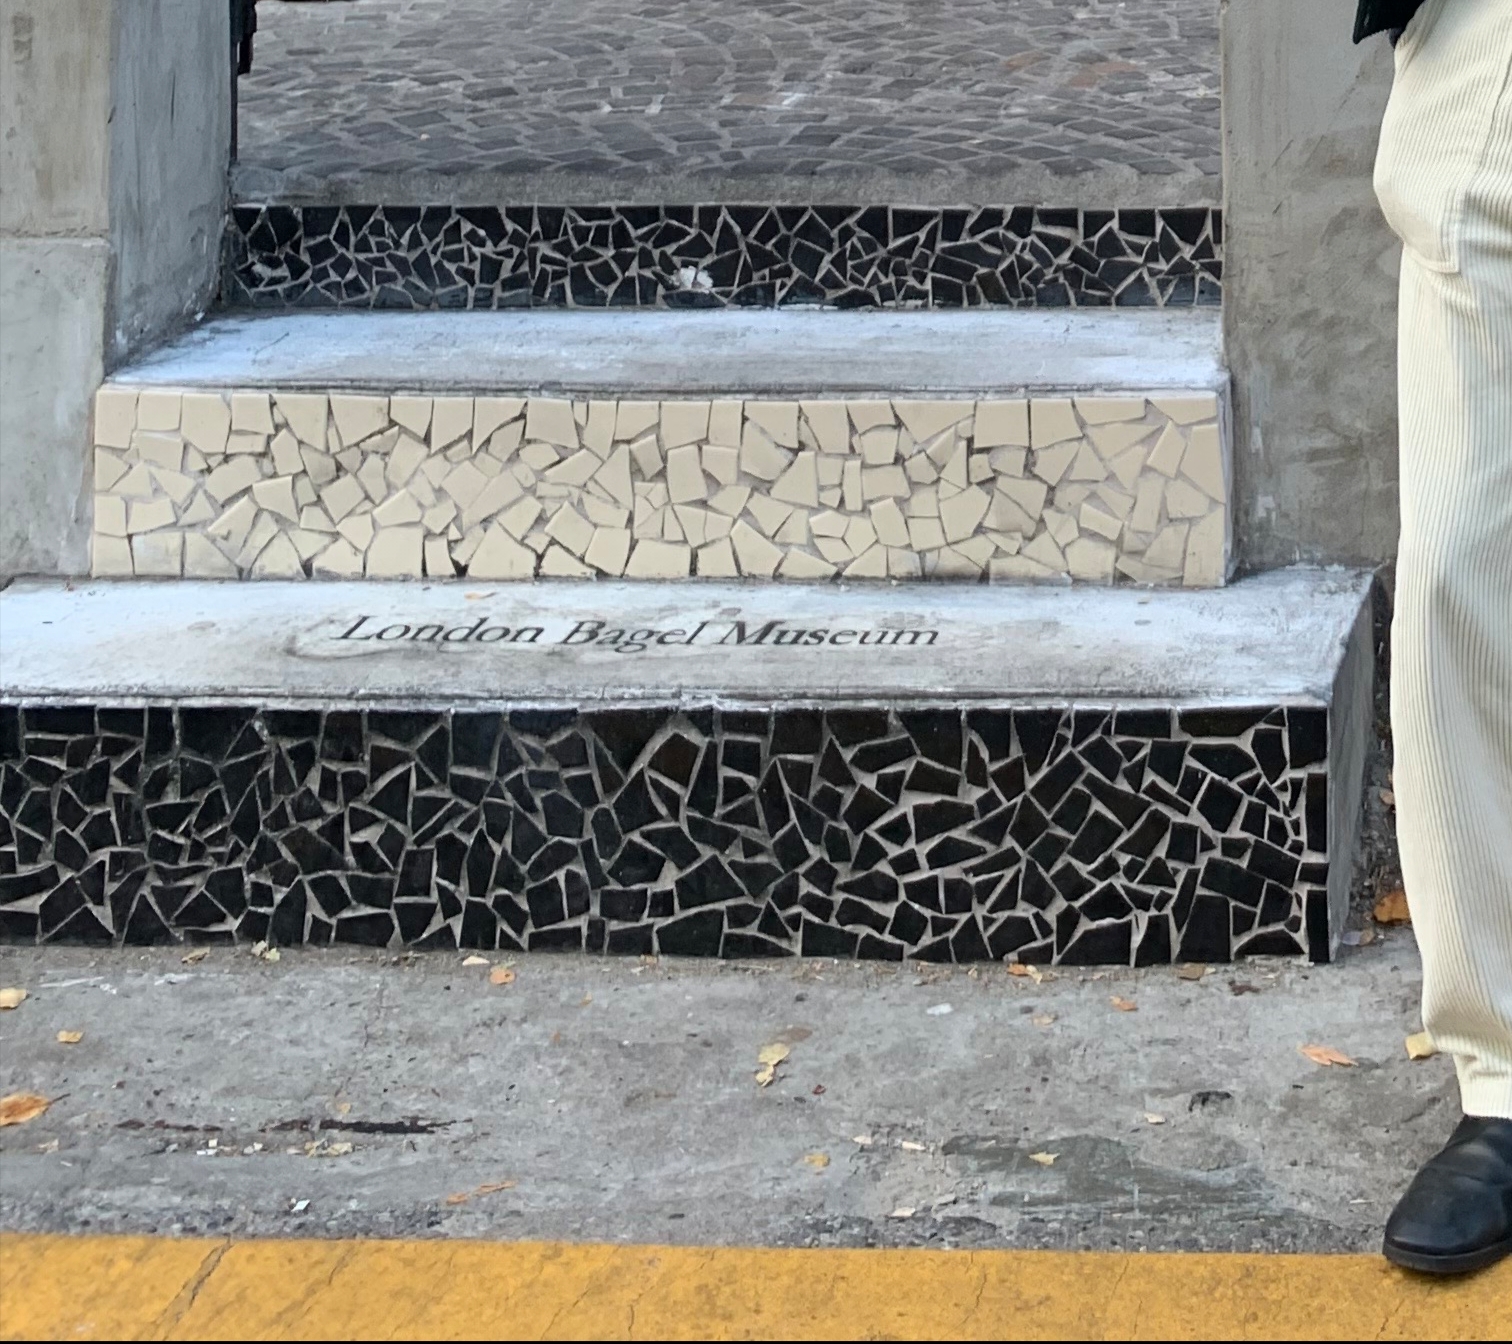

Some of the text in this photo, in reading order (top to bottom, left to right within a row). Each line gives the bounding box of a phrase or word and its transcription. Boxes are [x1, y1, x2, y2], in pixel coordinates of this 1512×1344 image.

[330, 615, 939, 653] London Bagel Museum
